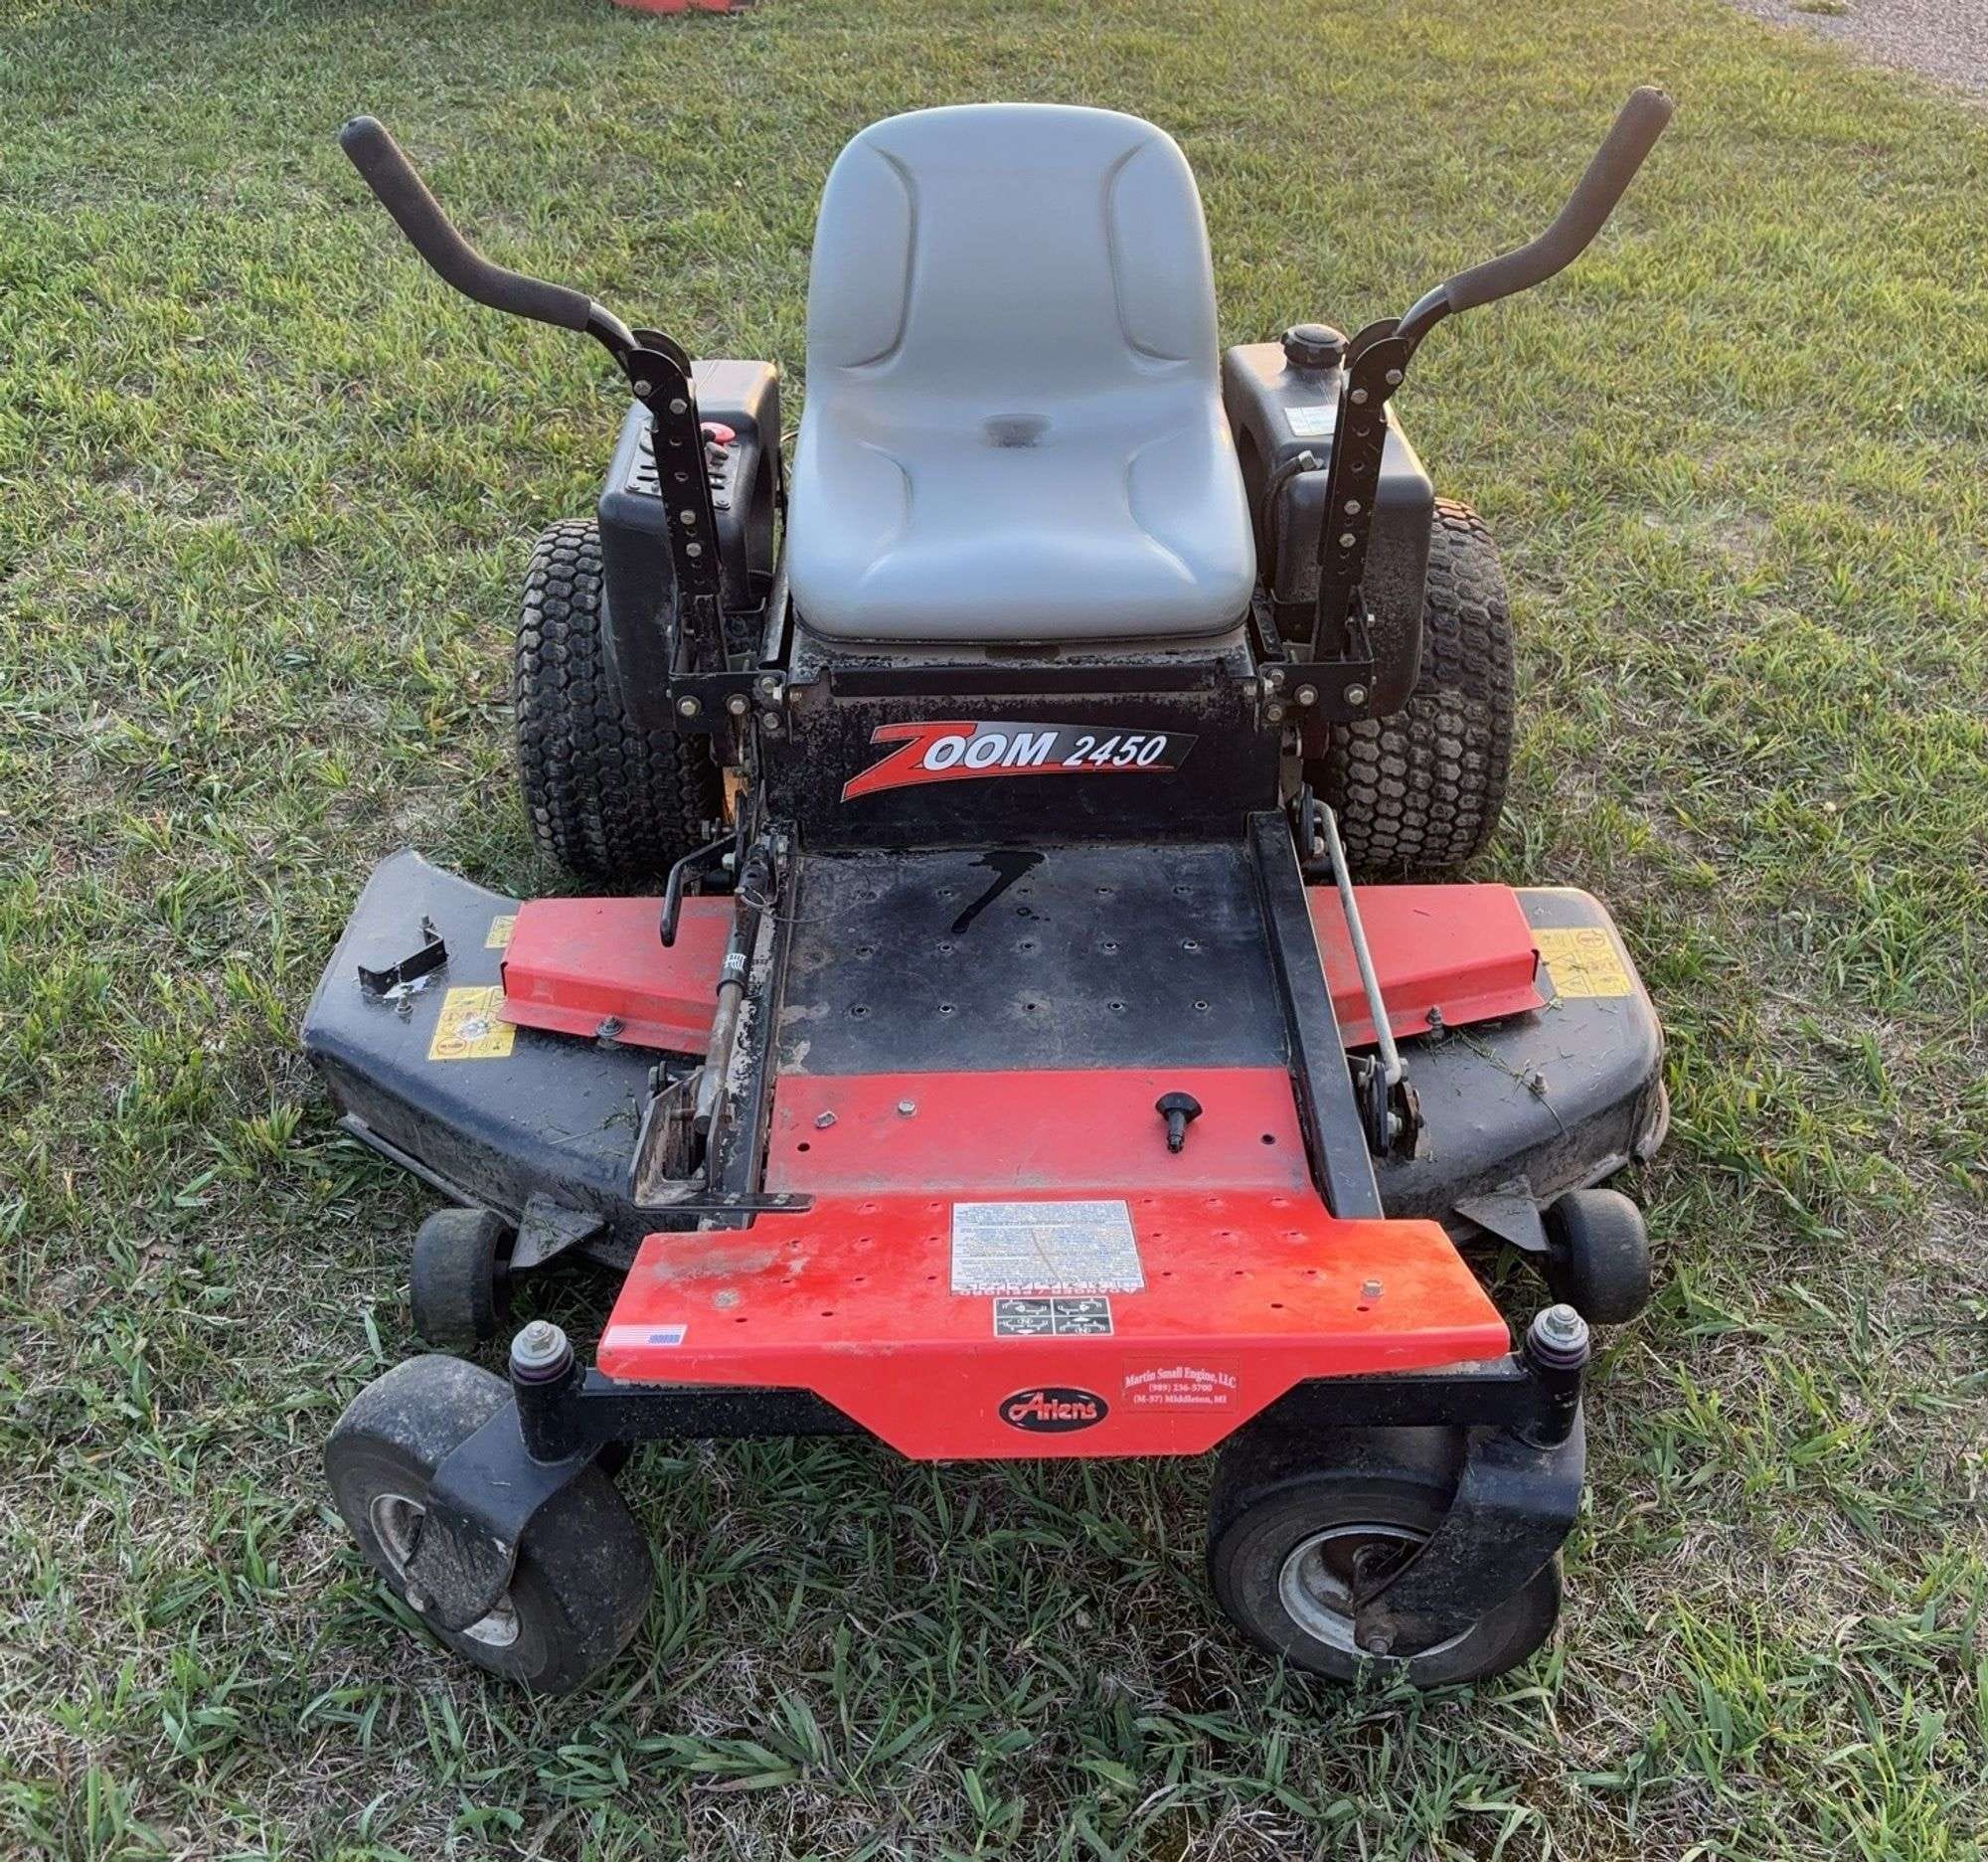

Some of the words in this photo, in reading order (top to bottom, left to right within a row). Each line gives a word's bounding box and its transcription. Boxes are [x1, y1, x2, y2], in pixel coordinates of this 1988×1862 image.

[840, 721, 1061, 802] ZOOM
[1063, 734, 1170, 767] 2450
[1125, 1370, 1156, 1387] Martin
[1157, 1367, 1183, 1379] Small
[1184, 1367, 1218, 1384] Engine,
[1219, 1372, 1237, 1389] LLC
[1008, 1392, 1097, 1422] Ariens
[1215, 1394, 1228, 1405] MI
